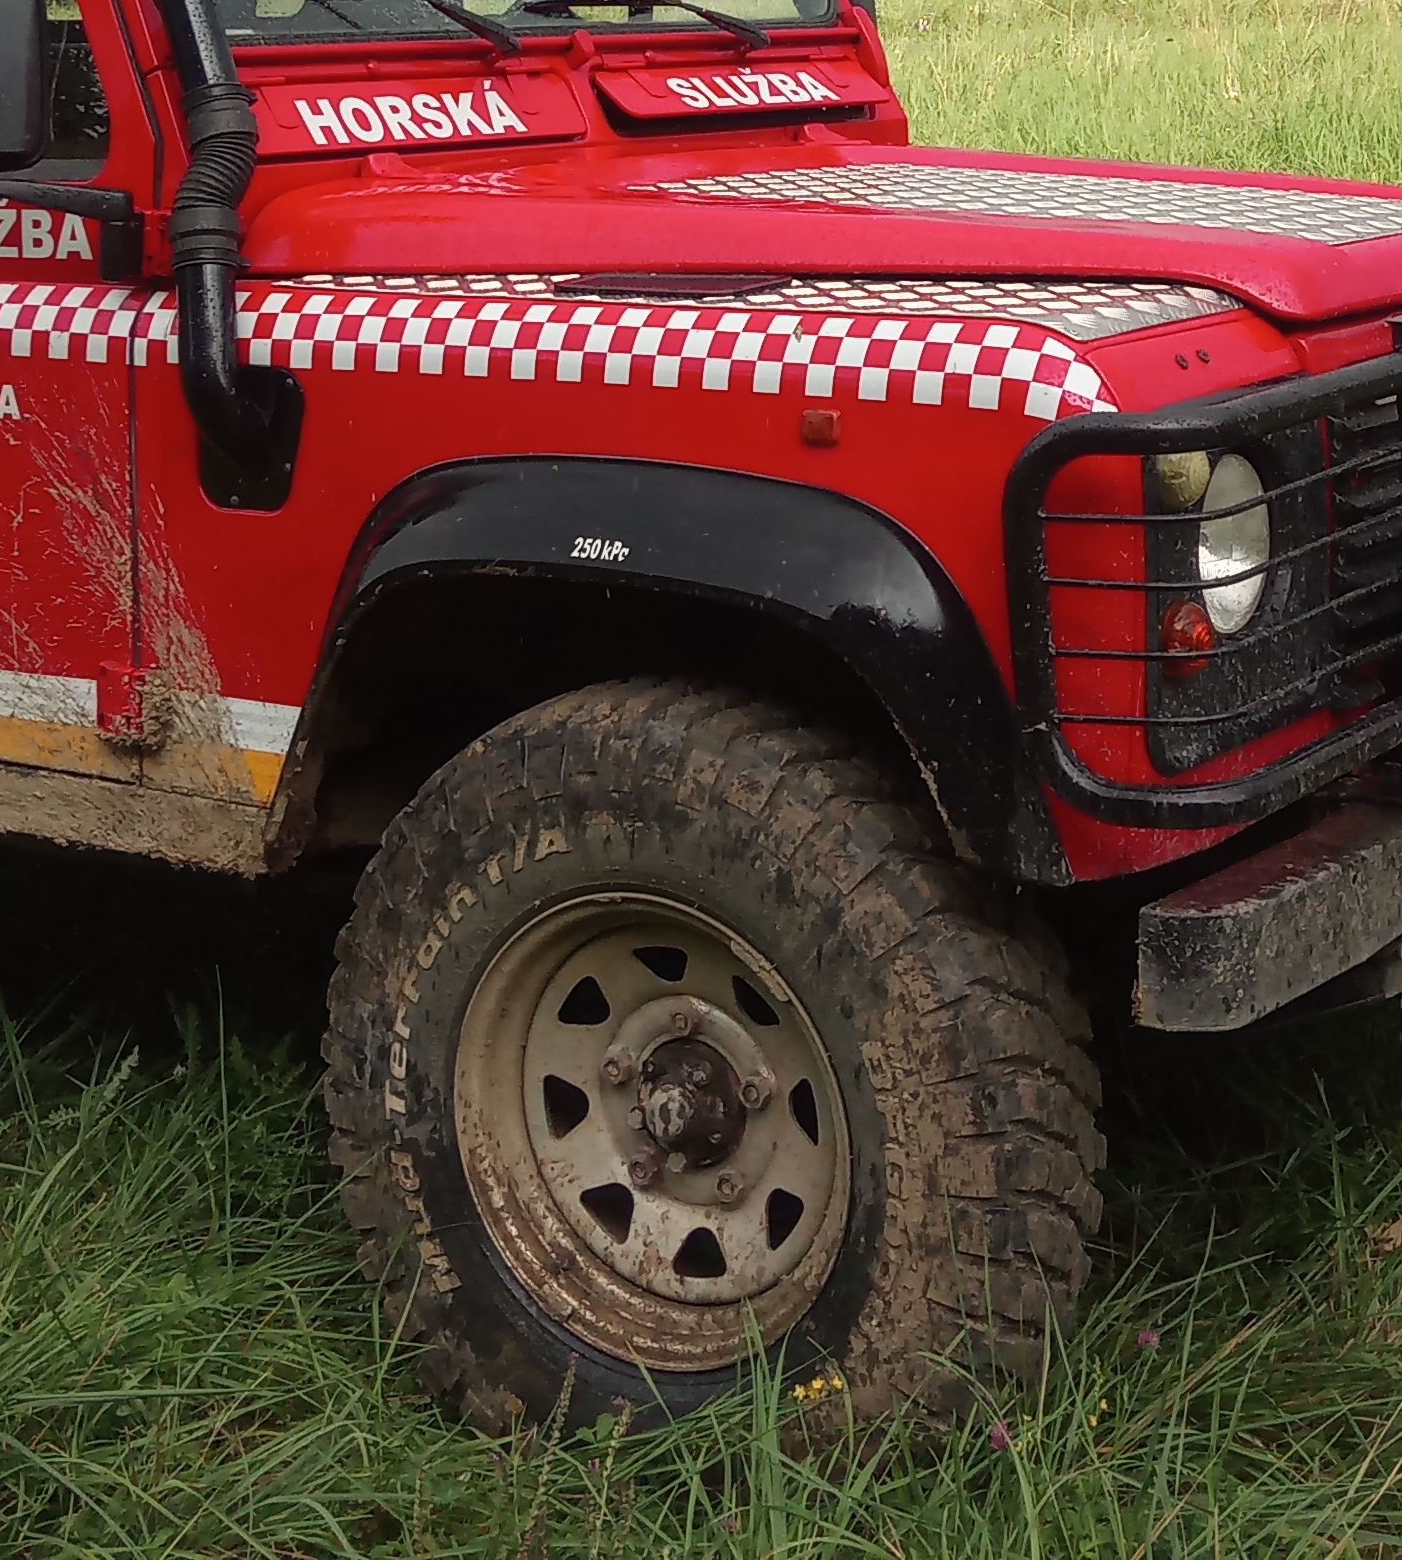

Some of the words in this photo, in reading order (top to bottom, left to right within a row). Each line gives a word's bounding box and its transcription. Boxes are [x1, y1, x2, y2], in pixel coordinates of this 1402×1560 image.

[295, 79, 527, 146] HORSKÁ
[666, 67, 840, 109] SLUŽBA
[570, 536, 602, 560] 250
